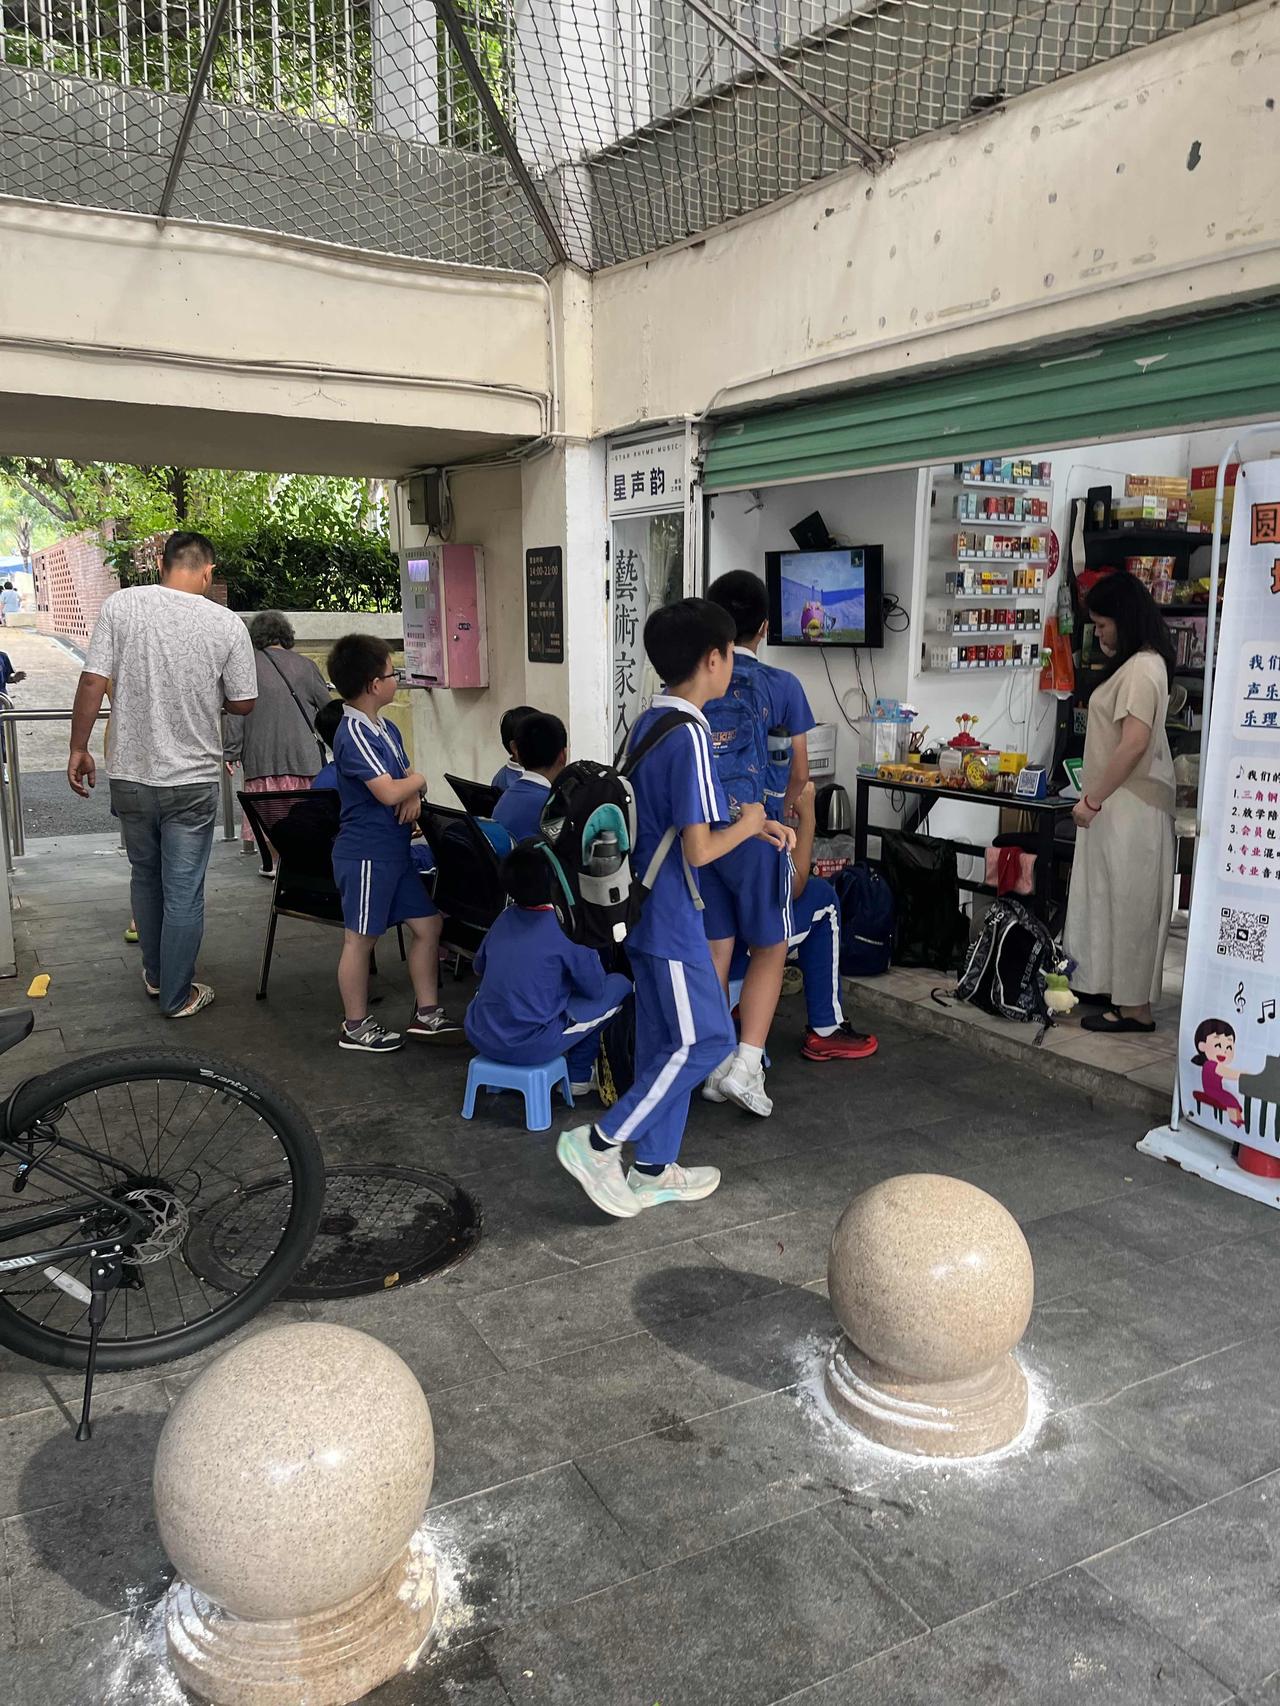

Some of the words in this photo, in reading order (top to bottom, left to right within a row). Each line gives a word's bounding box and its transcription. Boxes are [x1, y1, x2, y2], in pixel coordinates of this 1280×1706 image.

[613, 467, 665, 501] 星声韵
[1244, 709, 1278, 727] 乐理
